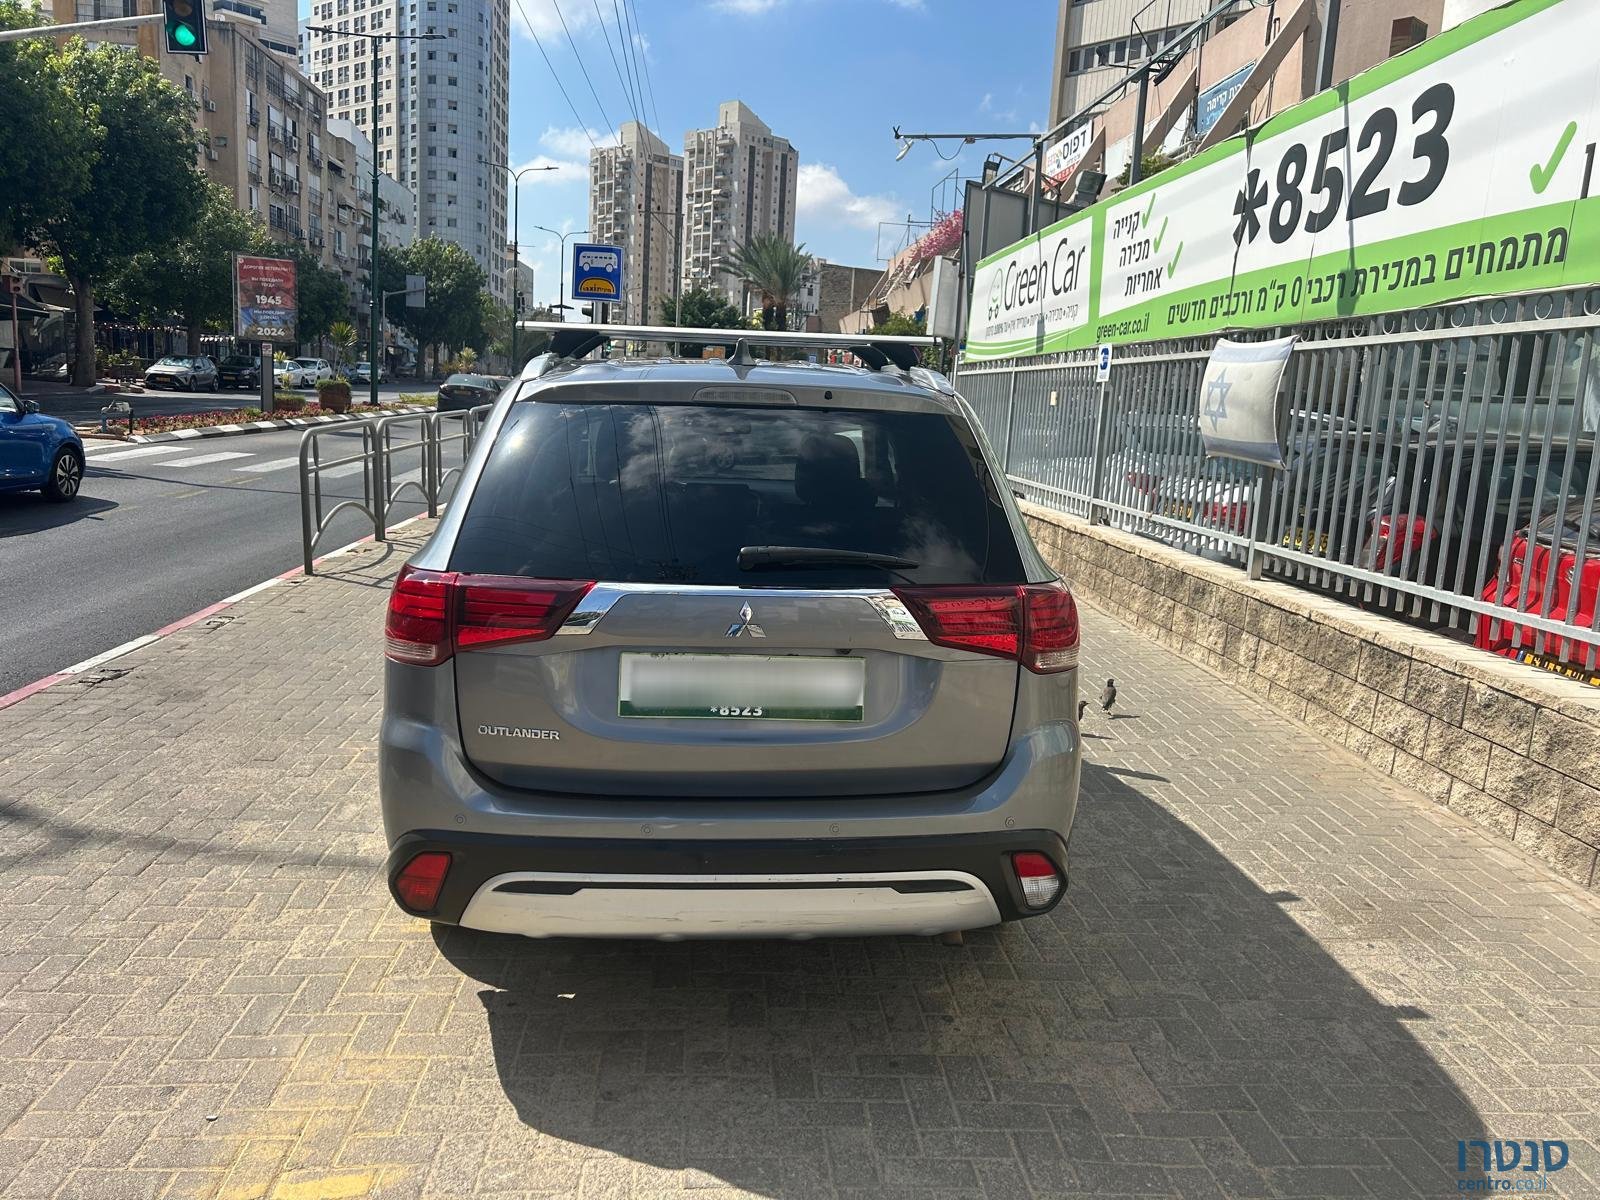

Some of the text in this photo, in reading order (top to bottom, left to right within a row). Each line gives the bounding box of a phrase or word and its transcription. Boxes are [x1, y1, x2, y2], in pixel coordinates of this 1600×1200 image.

[1062, 129, 1087, 160] דפוס
[1112, 211, 1140, 240] קנייה
[1119, 238, 1150, 268] מכירה
[1444, 226, 1568, 281] מתמחים
[1004, 237, 1086, 312] Green Car
[1124, 267, 1163, 297] אחריות
[1307, 270, 1346, 305] רכבי
[1351, 253, 1436, 297] במכירת
[255, 294, 282, 305] 1945
[1209, 289, 1254, 319] ורכבים
[1290, 275, 1302, 307] 0
[1167, 298, 1206, 326] חדשים
[257, 327, 285, 337] 2024
[1096, 312, 1150, 343] green-car.co.il
[477, 725, 561, 741] OUTLANDER
